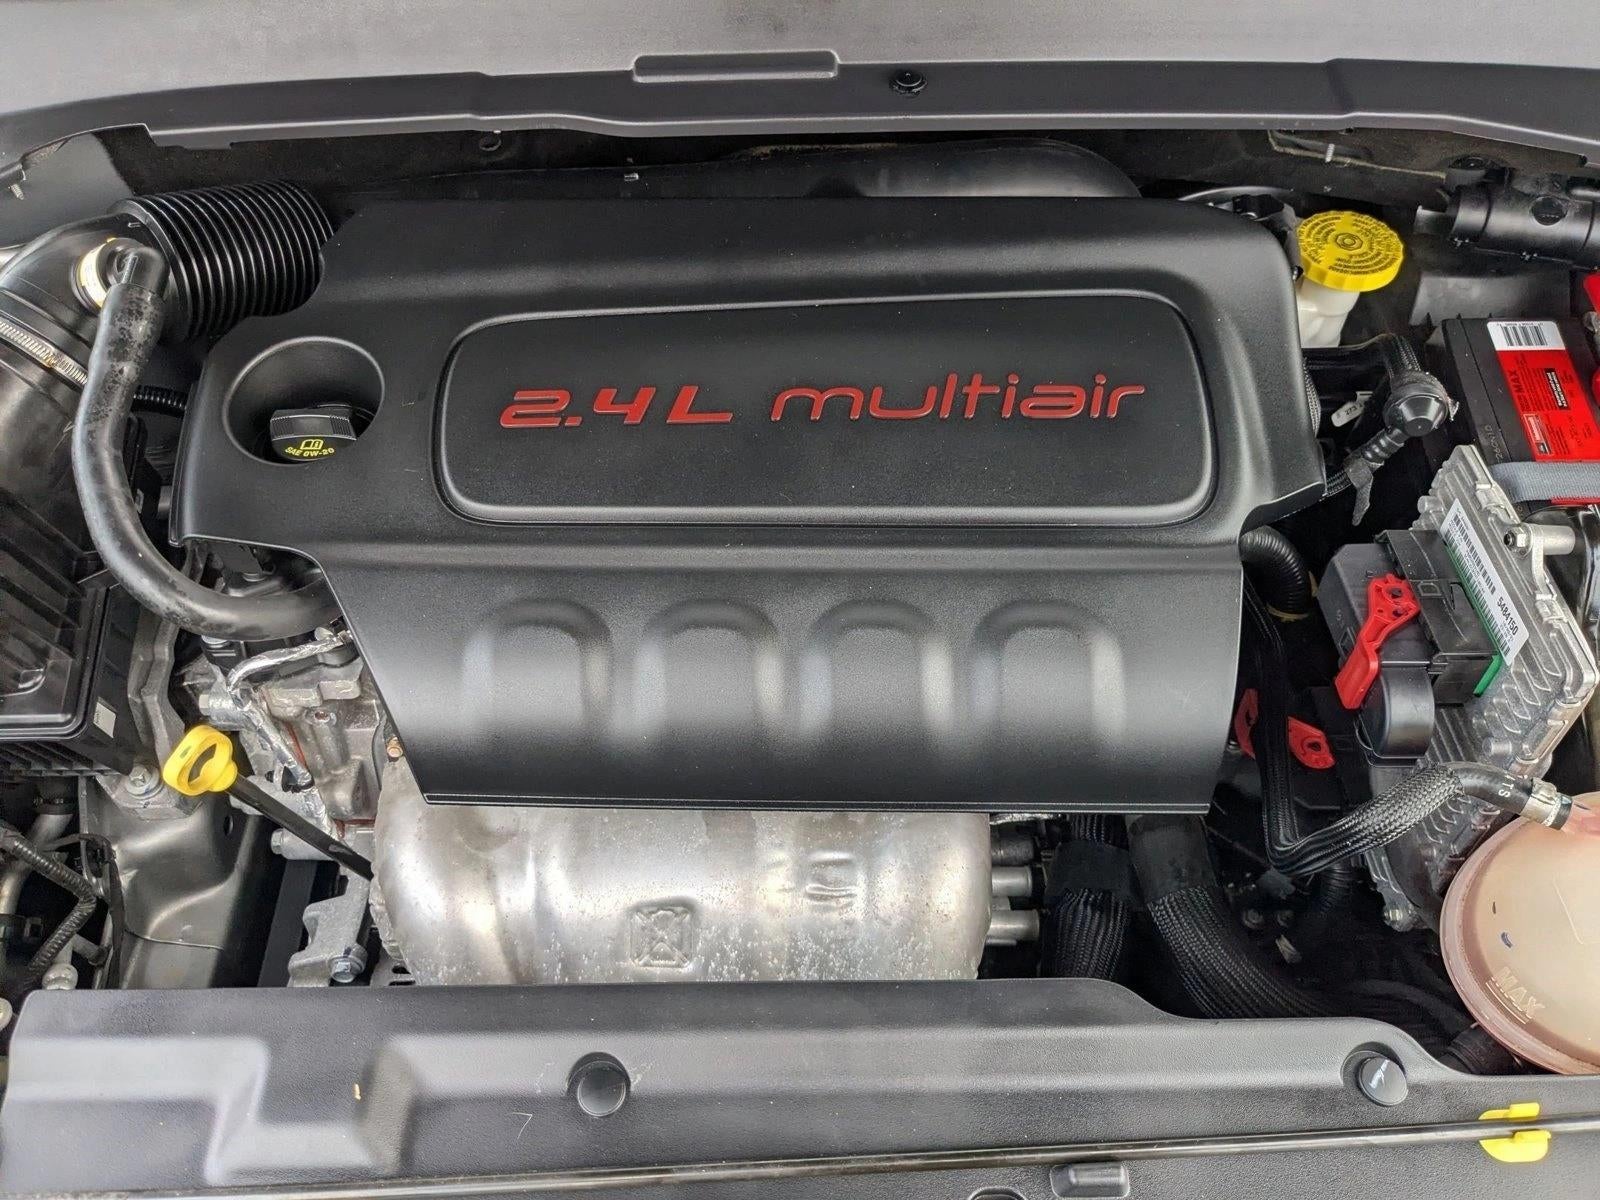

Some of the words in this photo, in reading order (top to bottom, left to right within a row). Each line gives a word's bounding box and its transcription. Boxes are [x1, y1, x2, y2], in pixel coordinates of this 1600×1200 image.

[770, 372, 1146, 422] multiair
[284, 446, 302, 456] SAE
[303, 447, 335, 457] 0W-20
[1496, 596, 1519, 636] 5484150
[1491, 966, 1546, 1019] MAX
